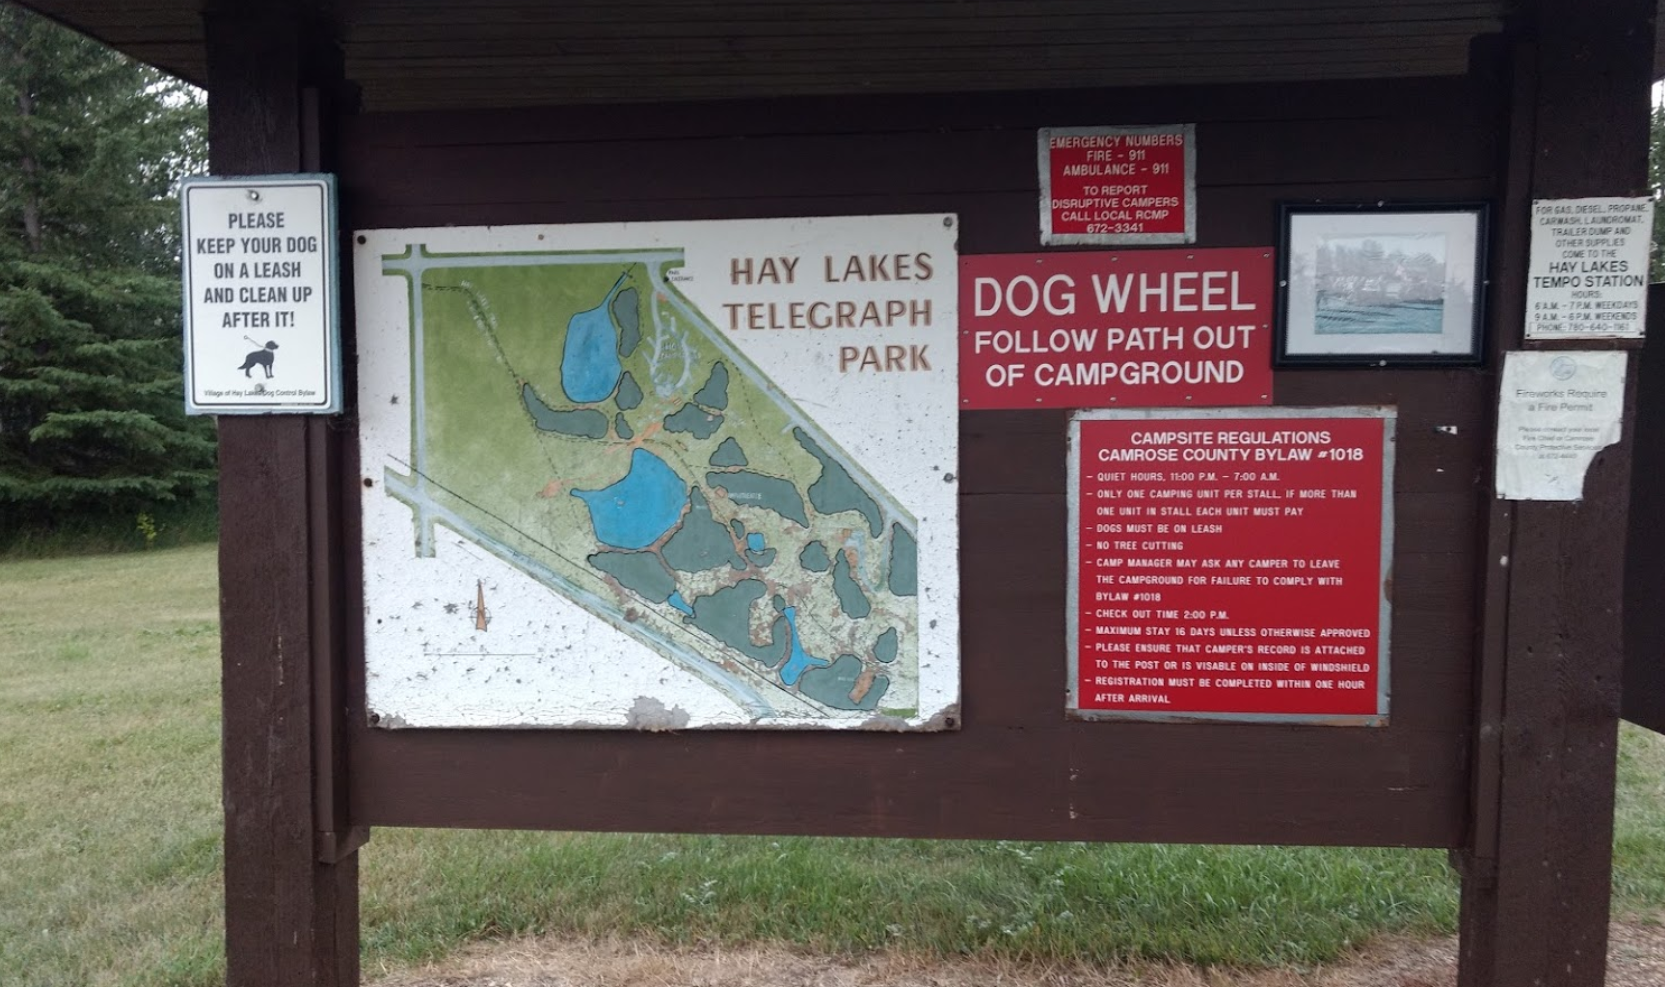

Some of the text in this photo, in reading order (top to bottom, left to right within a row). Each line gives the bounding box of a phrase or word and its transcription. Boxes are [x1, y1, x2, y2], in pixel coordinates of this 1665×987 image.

[1050, 134, 1183, 150] EMERGENCY NUMBERS
[1087, 150, 1145, 162] FIRE 911
[1063, 163, 1169, 176] AMBULANCE 911
[1083, 185, 1148, 196] TO REPORT
[1052, 197, 1179, 209] DISRUPTIVE CAMPERS
[229, 212, 284, 229] PLEASE
[1061, 210, 1169, 222] CALL LOCAL RCMP
[1087, 223, 1143, 234] 672-3341
[197, 236, 317, 254] KEEP YOUR DOG
[214, 261, 301, 279] ON A LEASH
[731, 252, 933, 285] HAY LAKES
[1550, 260, 1628, 273] HAY LAKES
[1534, 275, 1644, 288] TEMPO STATION
[204, 286, 312, 303] AND CLEAN UP
[975, 271, 1256, 317] DOG WHEEL
[222, 311, 294, 328] AFTER IT!
[722, 300, 932, 330] TELEGRAPH
[975, 325, 1256, 354] FOLLOW PATH OUT
[840, 345, 931, 373] PARK
[986, 360, 1244, 387] OF CAMPGROUND
[1516, 389, 1607, 398] Fireworks Require
[1538, 403, 1593, 412] Fire Permit
[1131, 431, 1331, 445] CAMPSITE REGULATIONS
[1099, 448, 1363, 462] CAMROSE COUNTY BYLAW #1018
[1097, 472, 1126, 482] QUIET
[1170, 472, 1194, 481] 11:00
[1234, 472, 1256, 481] 7:00
[1097, 489, 1122, 498] ONLY
[1127, 490, 1145, 498] ONE
[1150, 489, 1193, 498] CAMPING
[1197, 489, 1219, 498] UNIT
[1224, 489, 1243, 498] PER
[1286, 490, 1294, 498] IF
[1300, 489, 1326, 499] MORE
[1332, 489, 1357, 498] THAN
[1097, 507, 1303, 516] ONE UNIT STALL EACH UNIT MUST PAY
[1097, 524, 1222, 533] DOGS MUST BE ON LEASH
[1097, 541, 1183, 550] NO TREE CUTTING
[1097, 558, 1339, 568] CAMP MANAGER MAY ASK ANY CAMPER TO LEAVE
[1097, 575, 1343, 586] THE CAMPGROUND FOR FAILURE TO COMPLY WITH
[1096, 592, 1161, 602] BYLAW #1018
[1096, 609, 1127, 618] CHECK
[1132, 610, 1151, 618] OUT
[1156, 610, 1178, 619] TIME
[1184, 610, 1206, 619] 2:00
[1096, 626, 1370, 638] MAXIMUM STAY 16 DAYS UNLESS OTHERWISE APPROVED
[1096, 643, 1365, 655] PLEASE ENSURE THAT CAMPER'S RECORD IS ATTACHED
[1096, 660, 1370, 672] TO THE POST OR VISABLE ON INSIDE OF WINDSHIELD
[1096, 676, 1365, 689] REGISTRATION MUST BE COMPLETED WITHIN ONE HOUR
[1095, 693, 1170, 704] AFTER ARRIVAL
